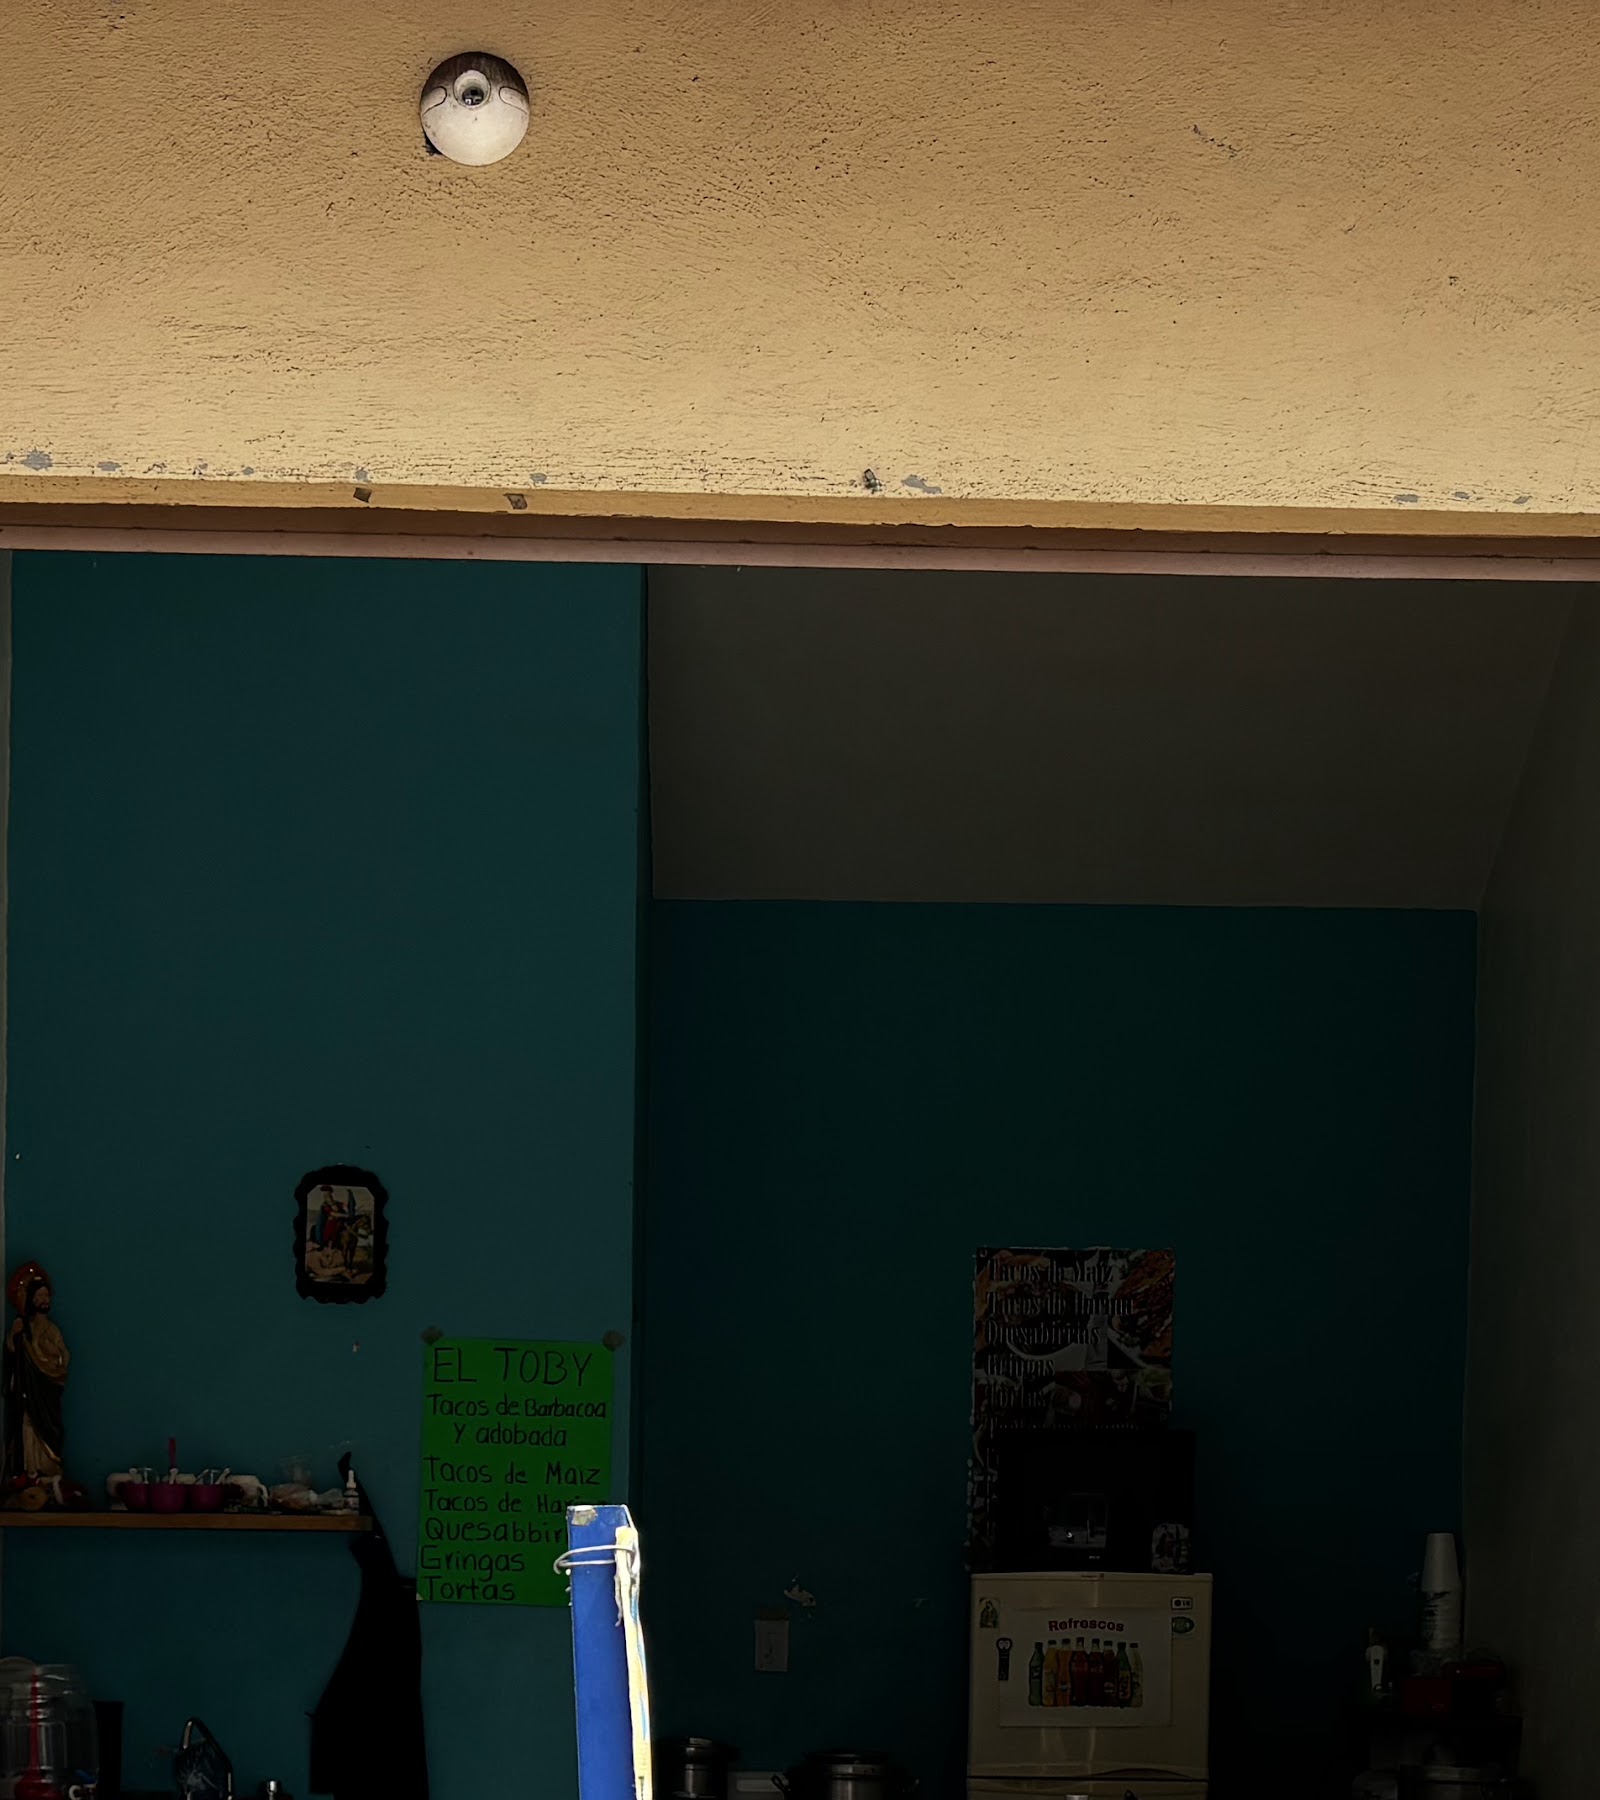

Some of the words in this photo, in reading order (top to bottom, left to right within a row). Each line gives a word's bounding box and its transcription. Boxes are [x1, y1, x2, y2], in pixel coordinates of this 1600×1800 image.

[433, 1347, 477, 1382] EL
[493, 1347, 593, 1387] TOBY
[426, 1393, 490, 1417] Tacos
[496, 1393, 520, 1416] de
[524, 1397, 608, 1418] Barbacoa
[475, 1421, 567, 1447] adobada
[424, 1454, 492, 1483] Tacos
[504, 1461, 528, 1484] de
[424, 1489, 488, 1512] Tacos
[498, 1491, 522, 1512] de
[425, 1517, 567, 1543] Quesabbir
[420, 1545, 525, 1582] Gringas
[424, 1576, 516, 1601] Tortas
[1048, 1618, 1125, 1632] Refrescos
